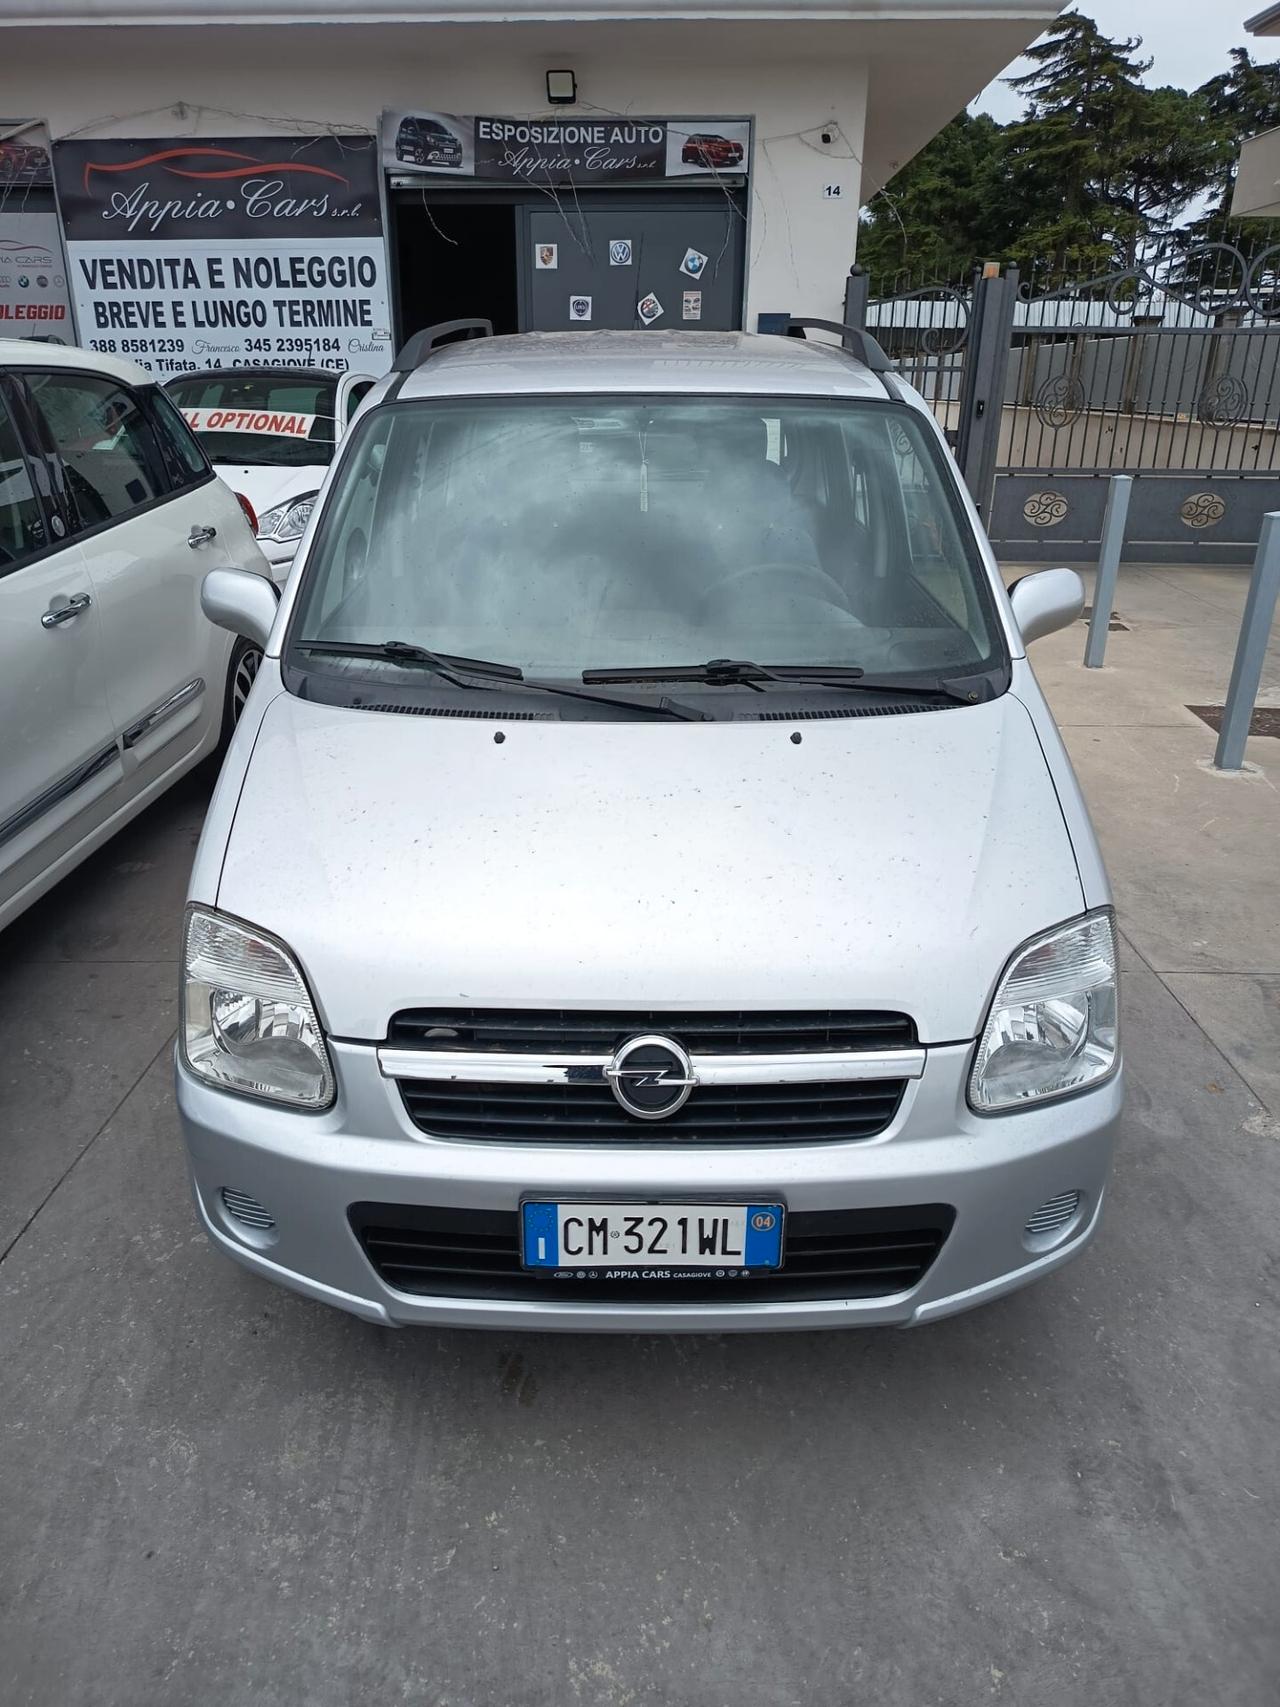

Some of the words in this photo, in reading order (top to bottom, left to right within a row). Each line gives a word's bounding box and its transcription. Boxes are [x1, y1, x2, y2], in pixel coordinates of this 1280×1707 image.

[479, 121, 605, 144] ESPOSIZIONE
[609, 126, 663, 144] AUTO
[498, 146, 572, 176] Appia
[583, 146, 638, 170] Cars
[825, 185, 841, 196] 14
[102, 182, 223, 232] Appia
[241, 179, 329, 218] Cars
[79, 258, 201, 290] VENDITA
[207, 258, 225, 289] E
[232, 256, 377, 289] NOLEGGIO
[93, 301, 167, 329] BREVE
[172, 301, 187, 328] E
[191, 300, 267, 328] LUNGO
[272, 299, 373, 327] TERMINE
[89, 339, 117, 353] 388
[121, 339, 185, 353] 8581239
[191, 339, 240, 354] Francesco
[244, 338, 272, 352] 345
[276, 338, 341, 352] 2395184
[348, 338, 384, 353] Cristina
[320, 358, 350, 371] (CE)
[206, 412, 307, 435] OPTIONAL
[756, 1215, 771, 1227] 04
[563, 1217, 609, 1256] CM
[623, 1217, 742, 1256] 321WL
[605, 1270, 640, 1279] APPIA
[642, 1270, 671, 1279] CARS
[673, 1271, 712, 1279] CASAGIOVE
